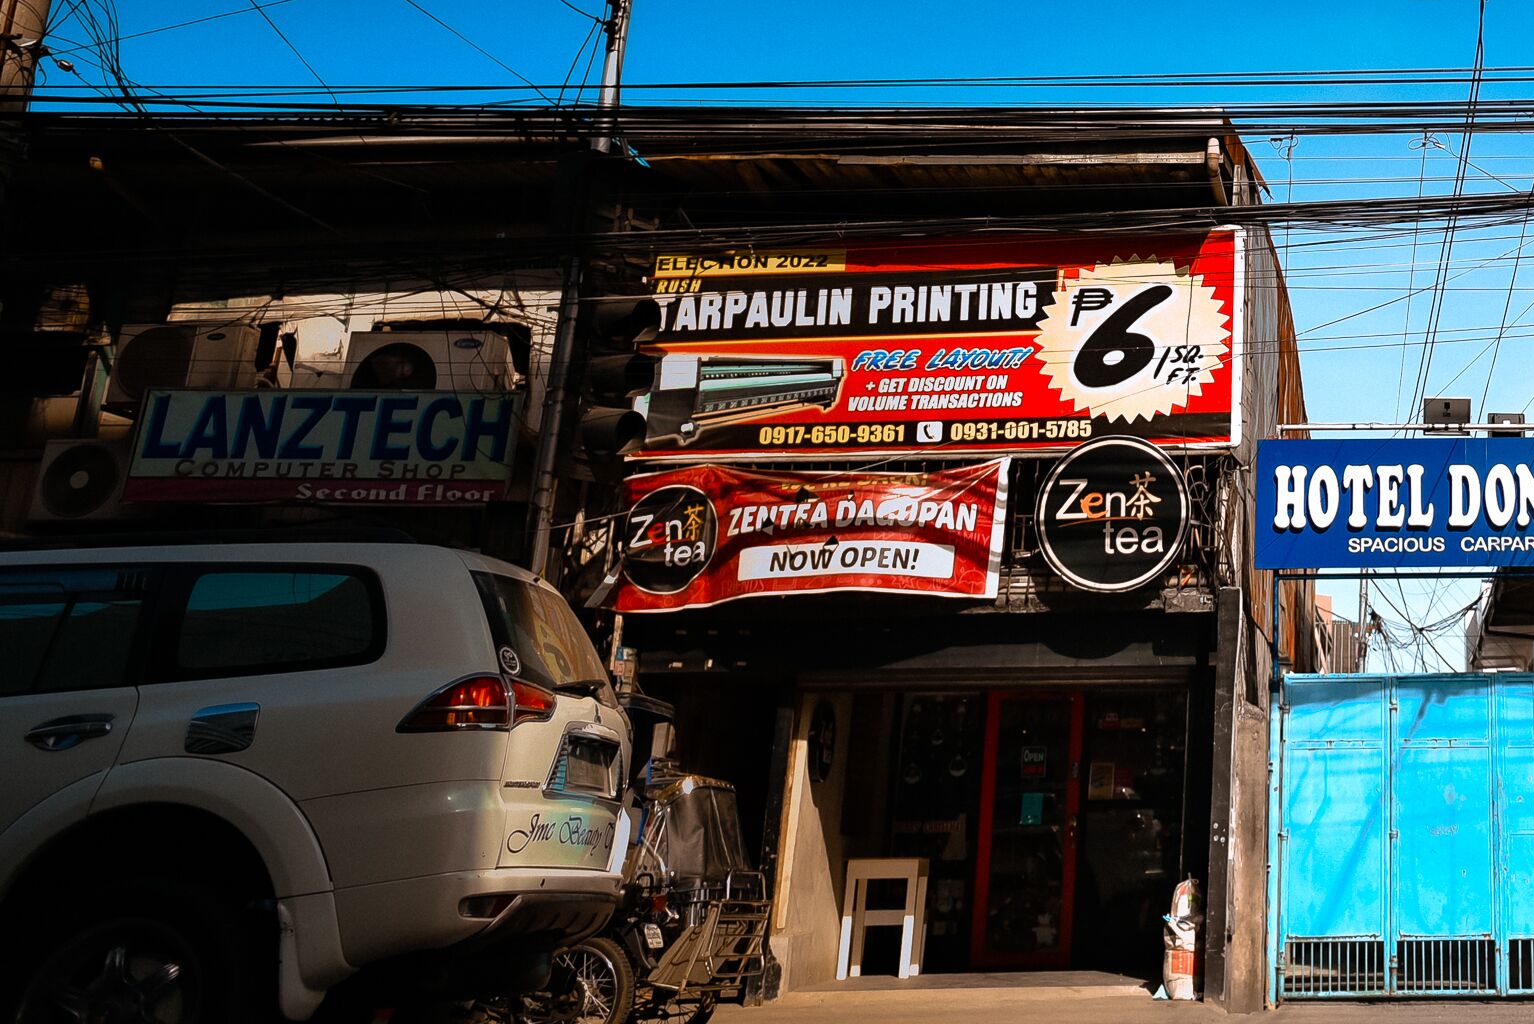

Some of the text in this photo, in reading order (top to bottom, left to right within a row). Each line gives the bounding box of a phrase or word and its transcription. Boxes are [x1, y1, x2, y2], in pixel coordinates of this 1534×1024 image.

[657, 254, 828, 272] ELECTION 2022
[656, 279, 702, 294] RUSH
[652, 282, 1037, 332] TARPAULIN PRINTING
[851, 346, 1034, 372] FREE LAYOUT!
[878, 378, 907, 394] GET
[908, 375, 985, 393] DISCOUNT
[986, 375, 1009, 390] ON
[848, 391, 1023, 412] VOLUME TRANSACTIONS
[142, 394, 513, 462] LANZTECH
[759, 419, 1092, 445] 0917-650-9361 0931-001-5785
[175, 459, 467, 478] COMPUTER SHOP
[296, 482, 495, 503] Second Floor
[1055, 478, 1126, 520] Zen
[1125, 471, 1162, 521] 茶
[1273, 463, 1435, 533] HOTEL
[628, 513, 683, 549] Zen
[682, 504, 705, 541] 茶
[727, 501, 828, 537] ZENTEA
[1102, 520, 1164, 554] tea
[1348, 536, 1445, 553] SPACIOUS
[663, 540, 706, 568] tea
[769, 546, 920, 572] NOW OPEN!
